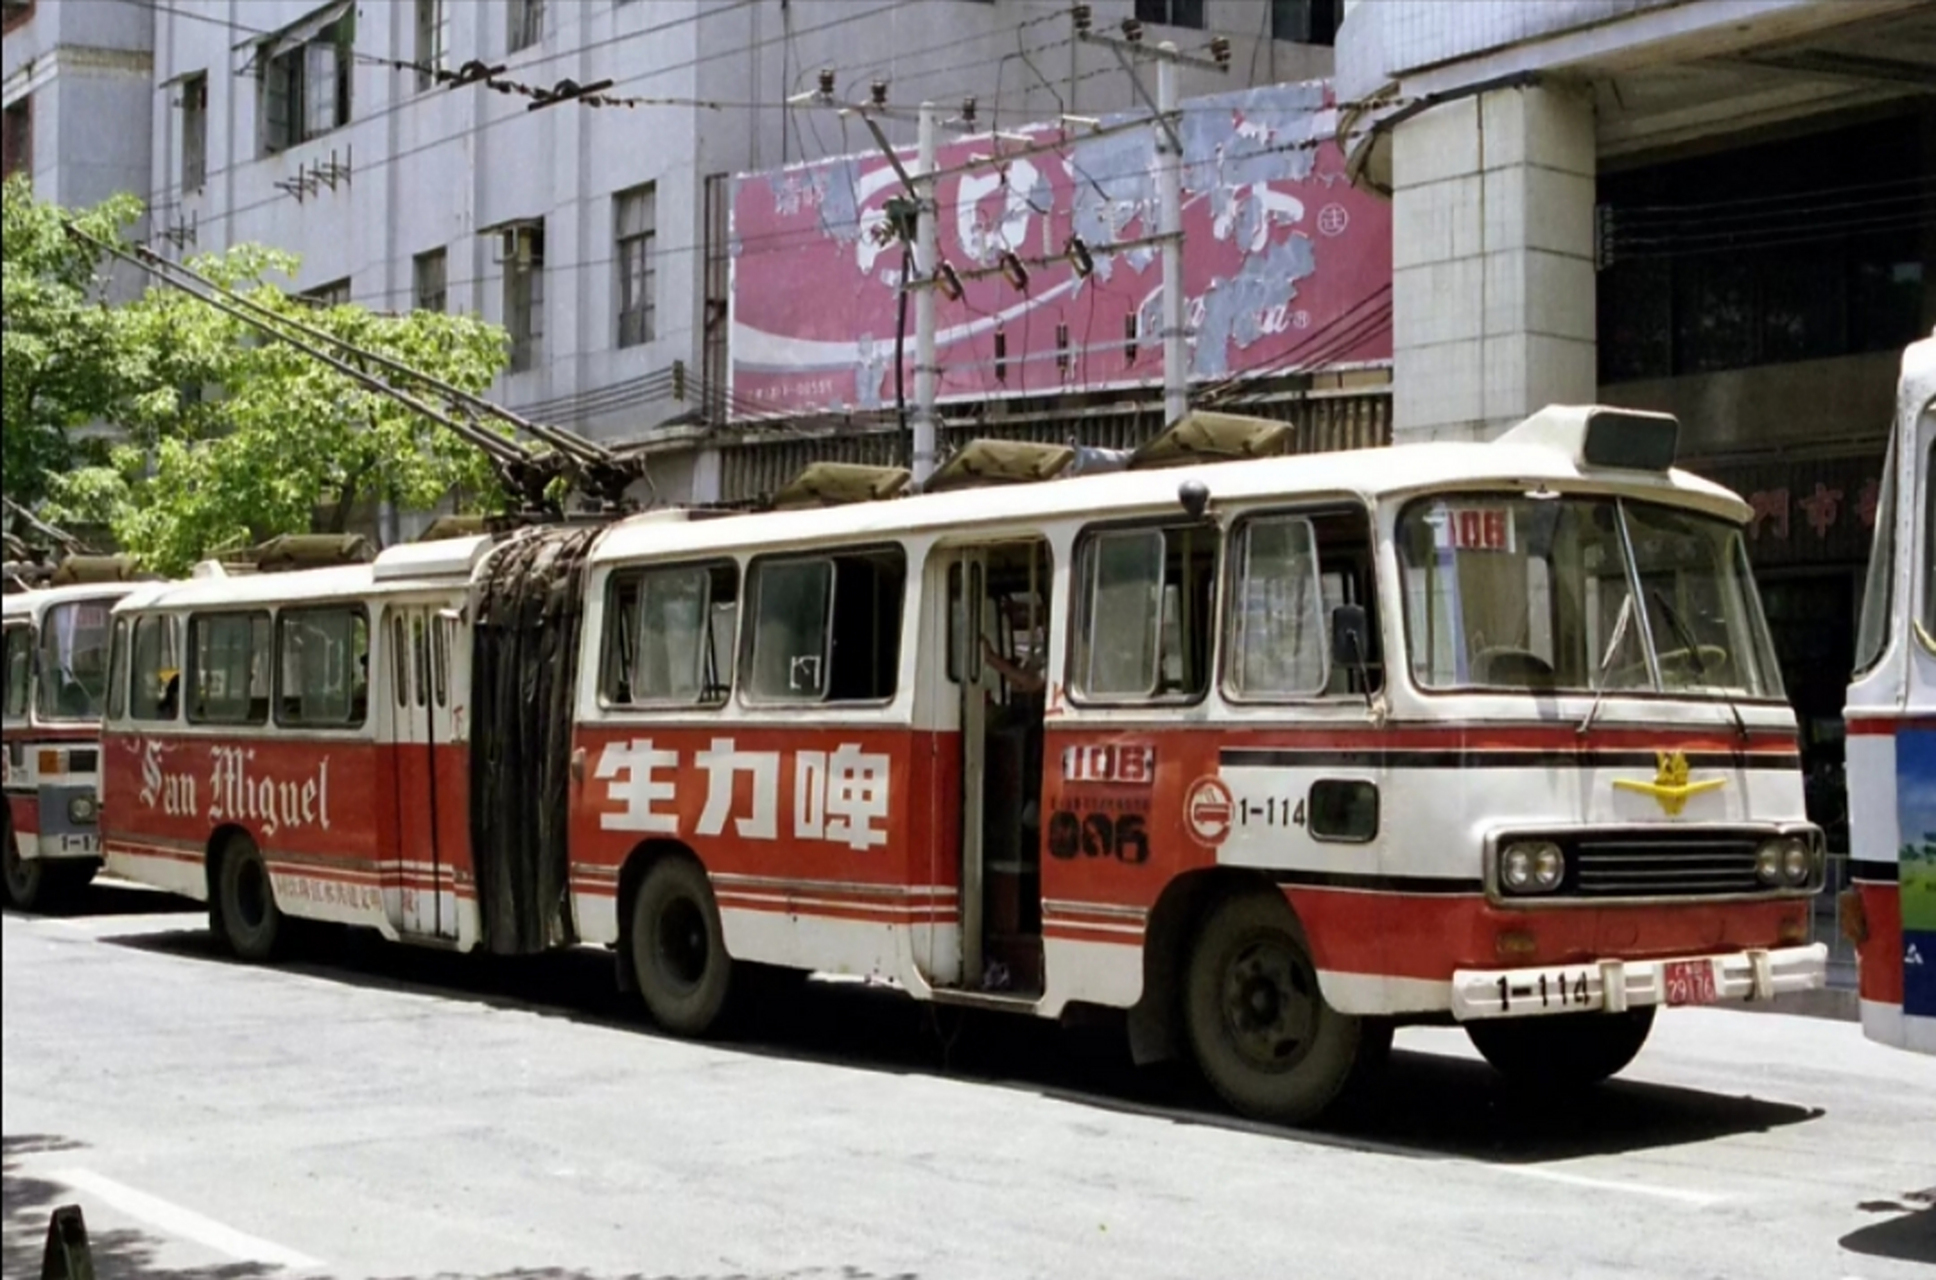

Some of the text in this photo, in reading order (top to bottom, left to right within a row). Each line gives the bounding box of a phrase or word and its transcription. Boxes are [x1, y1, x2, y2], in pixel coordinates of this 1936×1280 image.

[138, 739, 329, 836] San Miguel
[594, 738, 890, 851] 生力啤
[1240, 797, 1306, 827] 1-114
[1497, 971, 1590, 1011] 1-114
